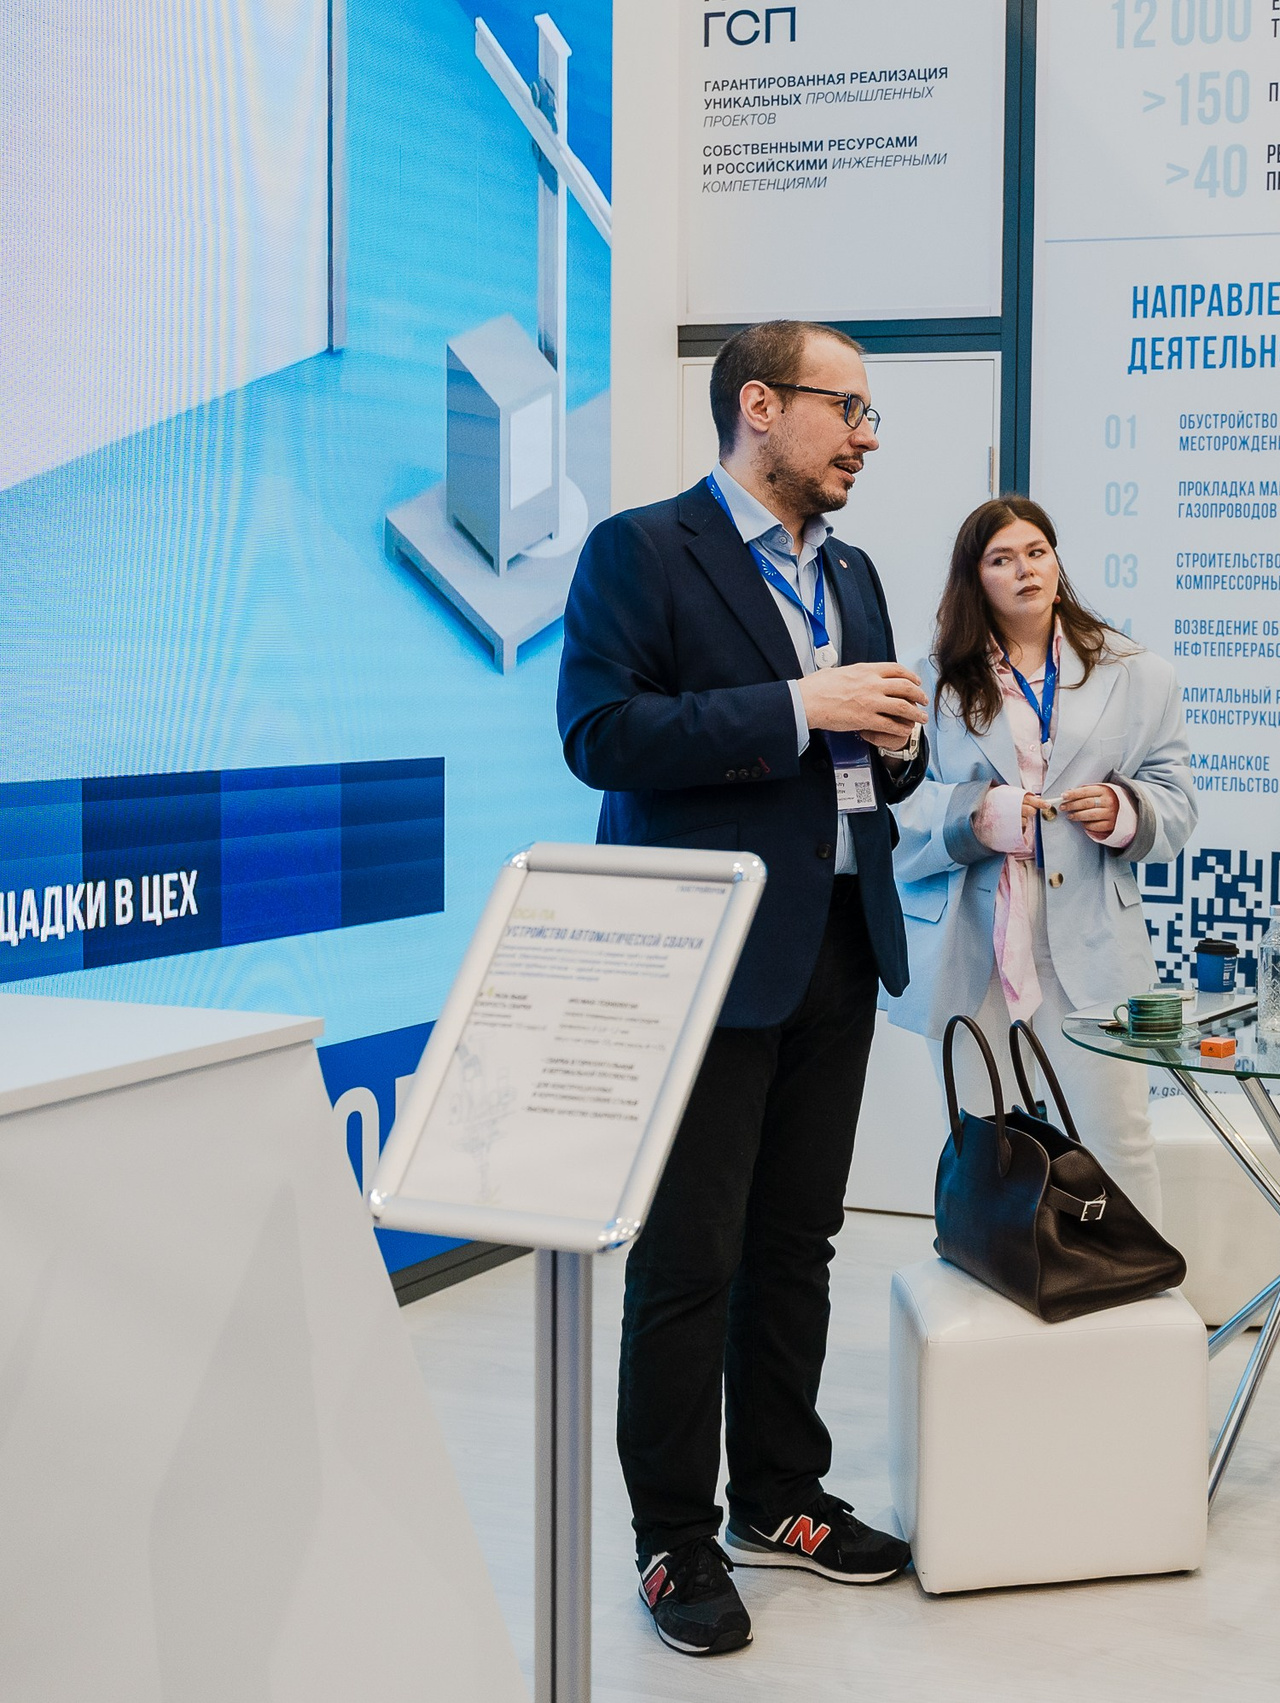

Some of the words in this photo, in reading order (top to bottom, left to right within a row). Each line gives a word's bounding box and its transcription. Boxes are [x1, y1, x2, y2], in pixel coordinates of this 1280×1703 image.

[703, 6, 796, 47] ГСП
[1111, 0, 1157, 49] 12
[704, 73, 845, 92] ГАРАНТИРОВАННАЯ
[850, 67, 948, 85] РЕАЛИЗАЦИЯ
[704, 93, 802, 110] УНИКАЛЬНЫХ
[805, 86, 934, 105] ПРОМЫШЛЕННЫХ
[703, 112, 776, 128] ПРОЕКТОВ
[703, 140, 823, 157] СОБСТВЕННЫМИ
[828, 136, 918, 152] РЕСУРСАМИ
[703, 164, 712, 175] И
[717, 158, 828, 175] РОССИЙСКИМИ
[832, 153, 947, 170] ИНЖЕНЕРНЫМИ
[1165, 143, 1248, 199] >40
[702, 176, 827, 193] КОМПЕТЕНЦИЯМИ
[1179, 410, 1278, 430] ОБУСТРОЙСТВО
[1104, 414, 1137, 449] 01
[1104, 481, 1139, 517] 02
[1178, 481, 1256, 498] ПРОКЛАДКА
[1178, 503, 1278, 520] ГАЗОПРОВОДОВ
[1104, 553, 1138, 589] 03
[1174, 619, 1258, 637] ВОЗВЕДЕНИЕ
[1178, 685, 1272, 705] АПИТАЛЬНЫЙ
[1189, 753, 1270, 772] АЖДАНСКОЕ
[1192, 775, 1279, 794] ОИТЕЛЬСТВО
[116, 879, 133, 926] В
[142, 869, 198, 926] ЦЕХ
[783, 1514, 831, 1555] N
